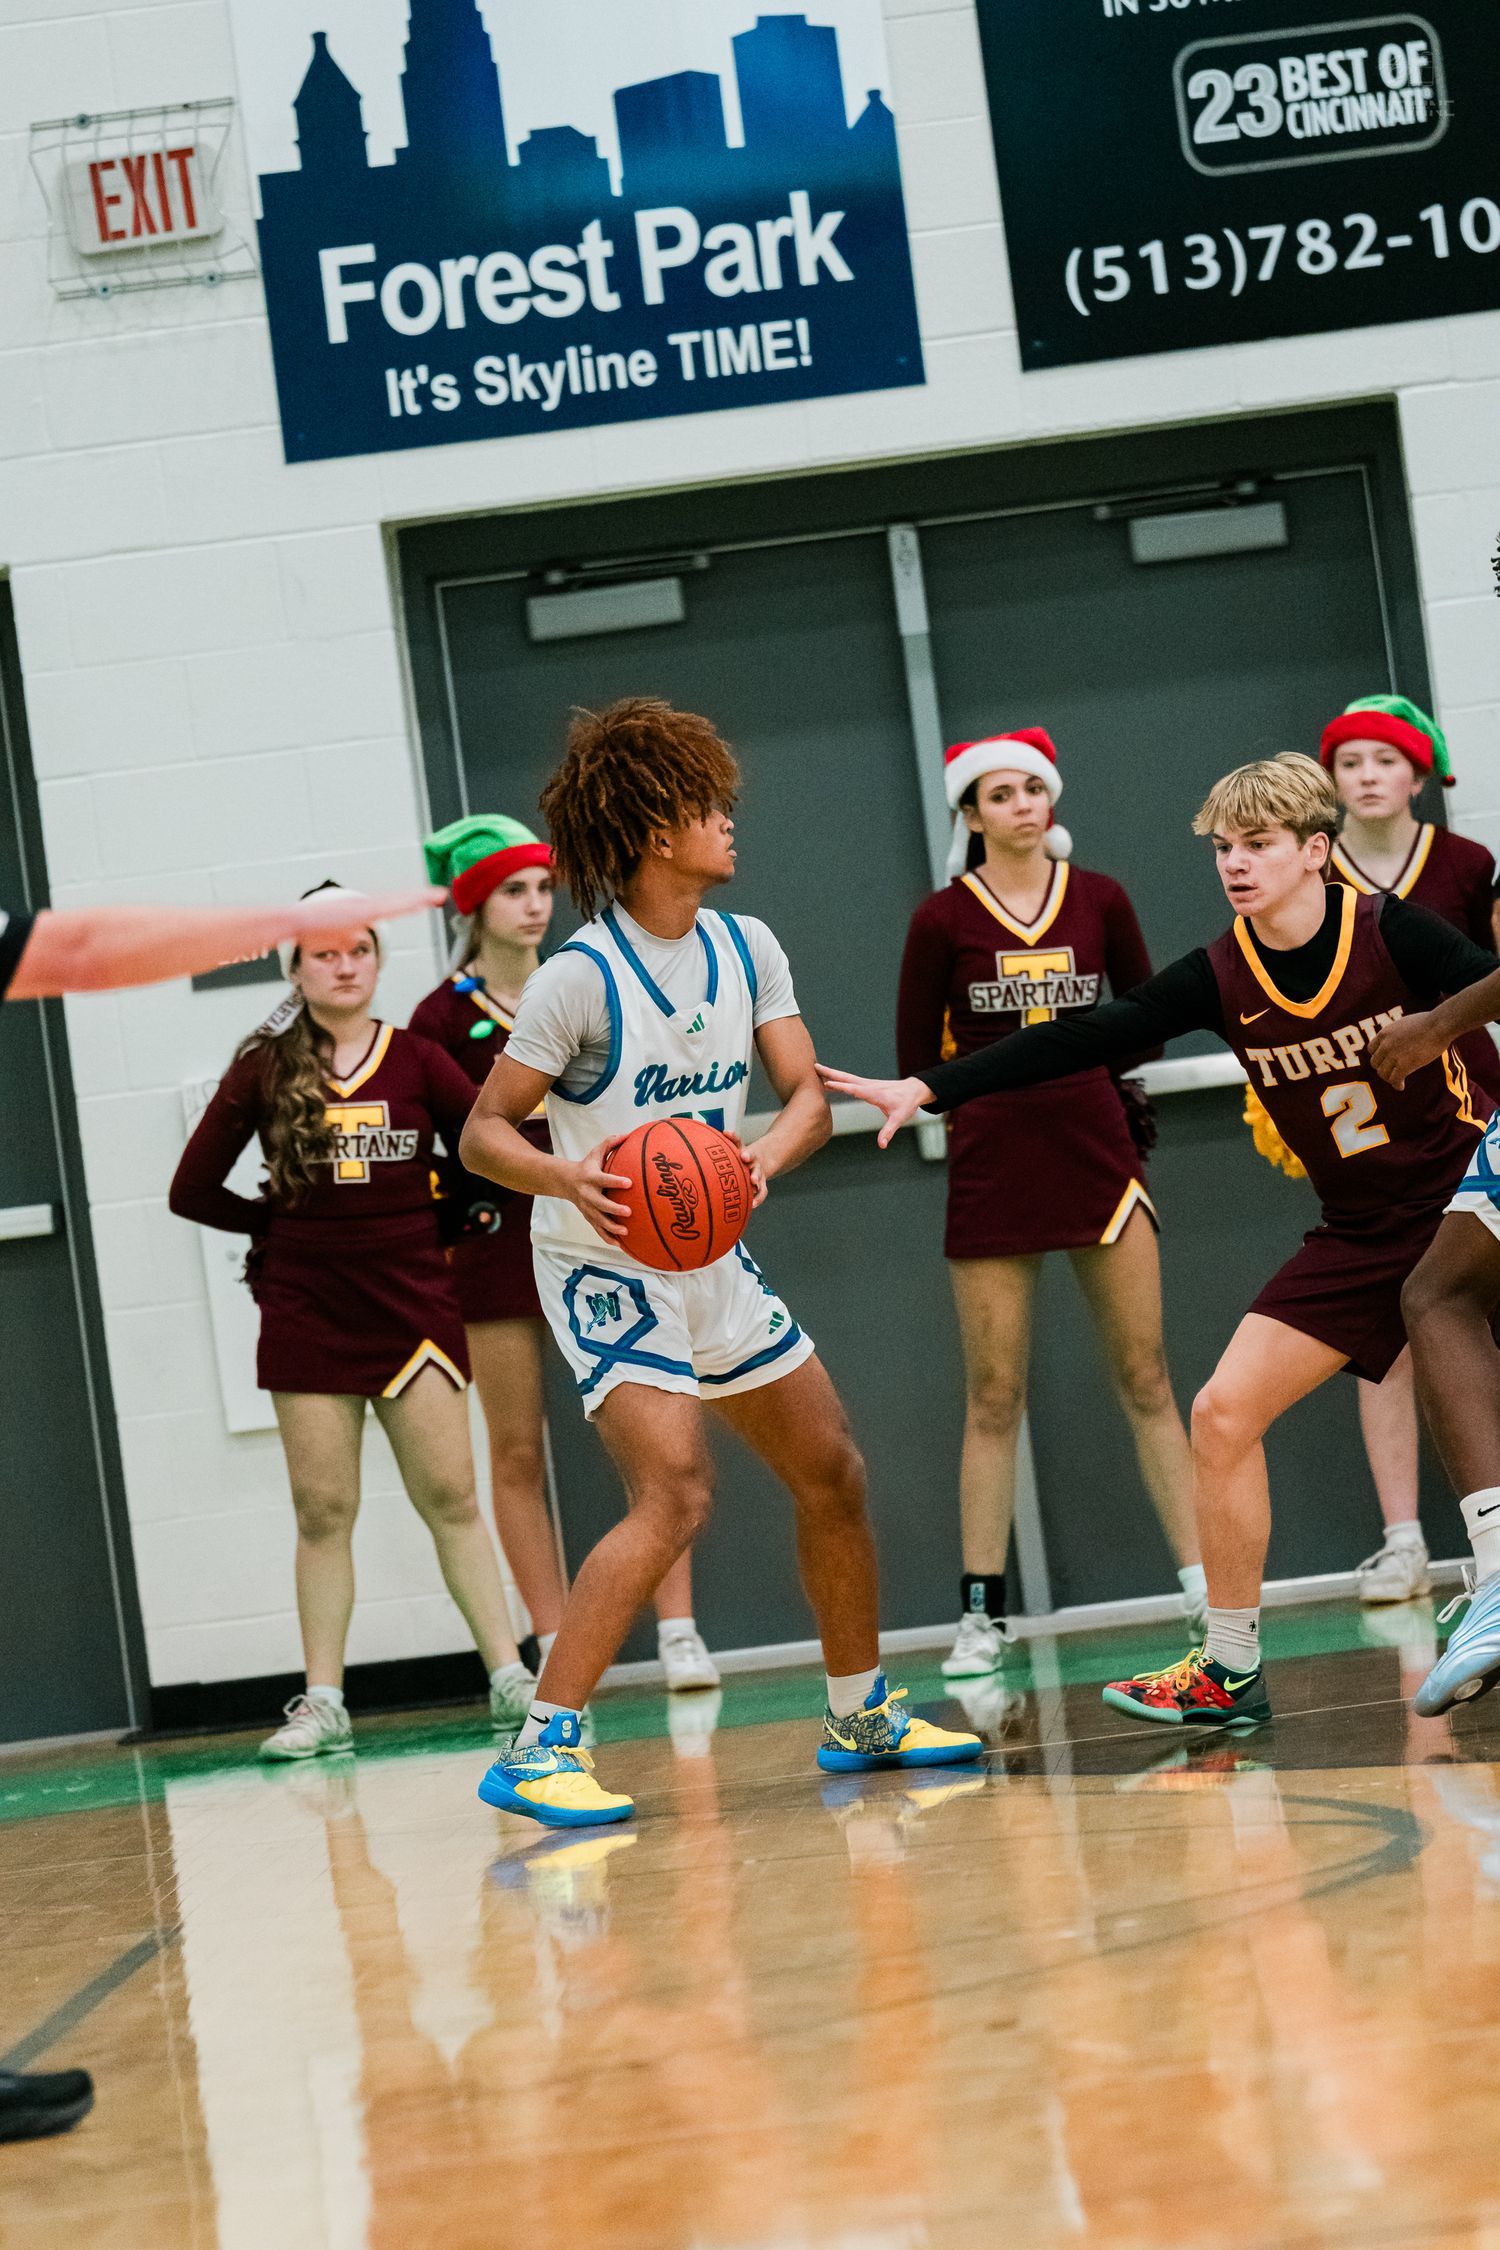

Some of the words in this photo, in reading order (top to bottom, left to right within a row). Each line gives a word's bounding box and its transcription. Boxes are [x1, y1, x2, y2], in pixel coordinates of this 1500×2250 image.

[1187, 63, 1283, 144] 23
[1278, 47, 1368, 102] BEST
[1378, 40, 1428, 89] OF
[88, 147, 197, 244] EXIT
[318, 218, 622, 344] Forest
[634, 189, 855, 305] Park
[385, 364, 461, 417] It's
[473, 344, 658, 412] Skyline
[667, 318, 812, 381] TIME!
[970, 975, 1098, 1011] SPARTANS
[335, 1132, 417, 1159] RTANS
[1320, 1081, 1390, 1159] 2
[652, 1152, 700, 1241] Rawlings
[705, 1144, 742, 1224] OHSAA
